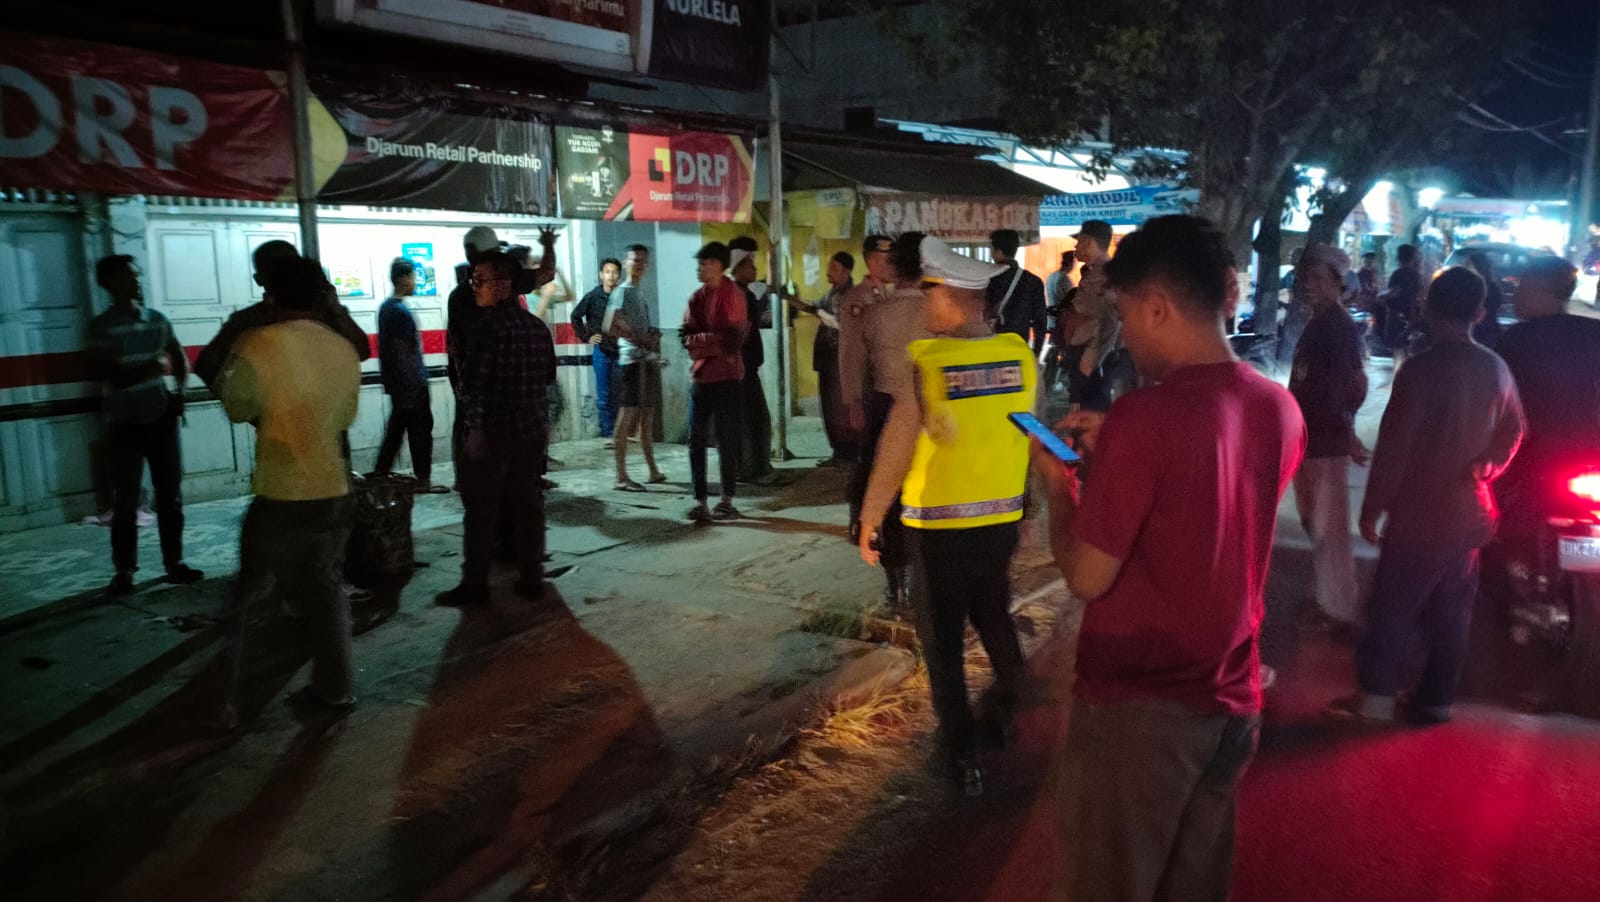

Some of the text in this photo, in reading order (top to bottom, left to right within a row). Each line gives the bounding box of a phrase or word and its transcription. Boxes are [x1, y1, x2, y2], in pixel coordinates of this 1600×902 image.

[0, 64, 208, 170] DRP
[366, 136, 542, 172] Djarum Retail Partnership
[675, 150, 729, 187] DRP
[885, 199, 999, 232] PANGKAS
